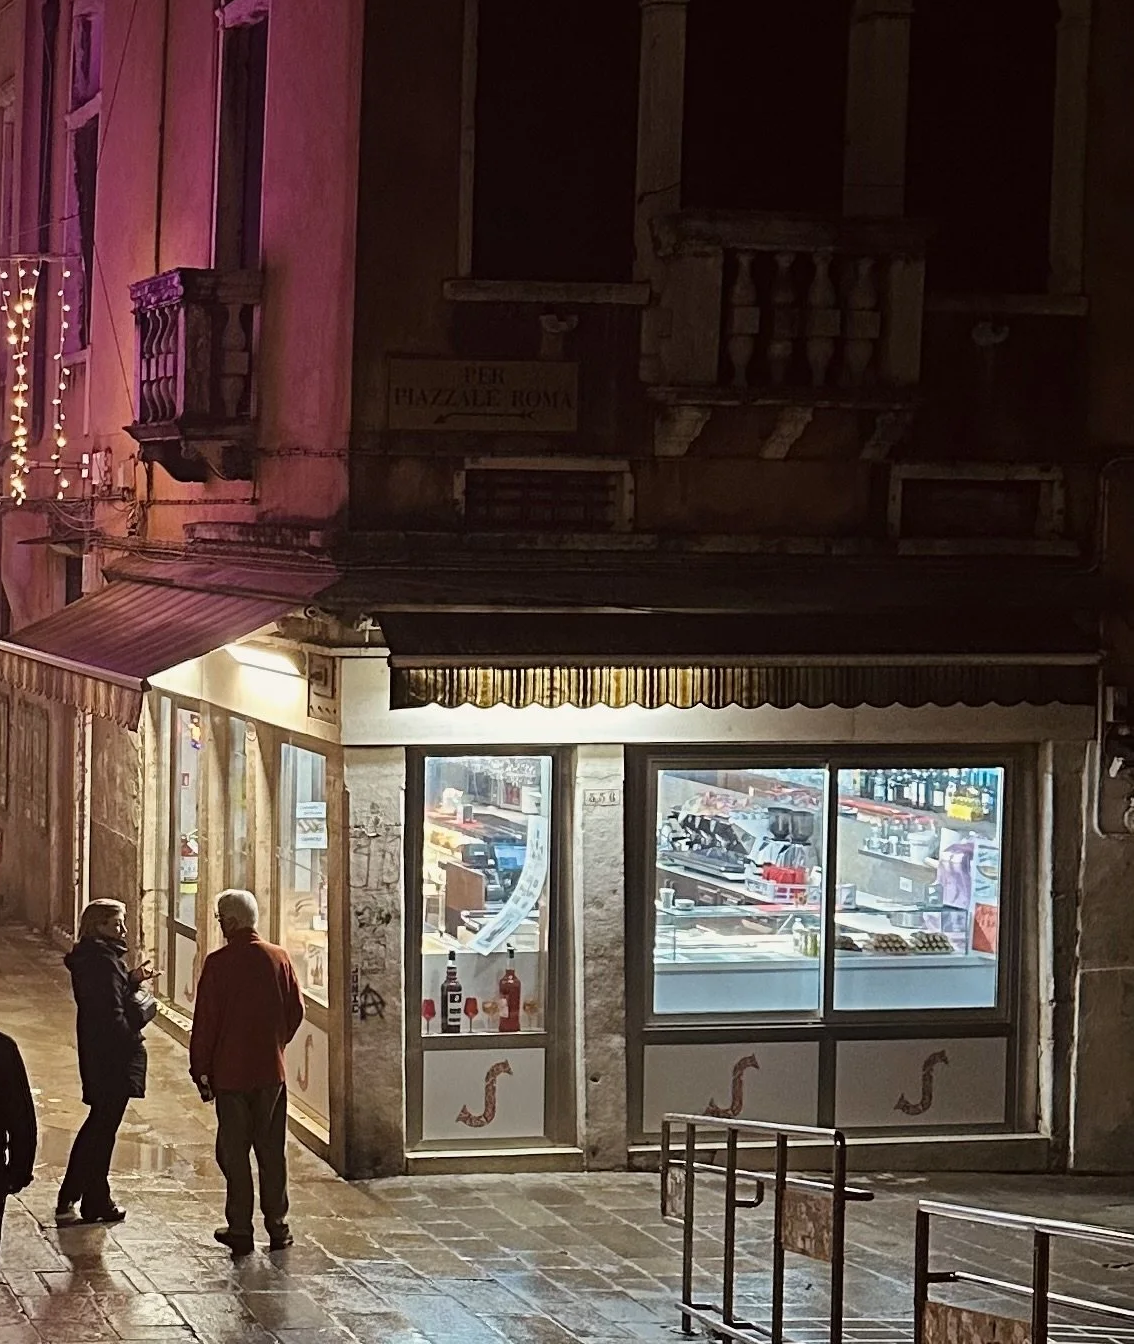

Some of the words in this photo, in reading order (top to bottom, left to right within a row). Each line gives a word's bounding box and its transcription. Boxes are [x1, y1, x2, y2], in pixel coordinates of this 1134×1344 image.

[464, 366, 505, 385] PER
[394, 388, 501, 408] PIAZZALE
[511, 389, 574, 410] ROMA
